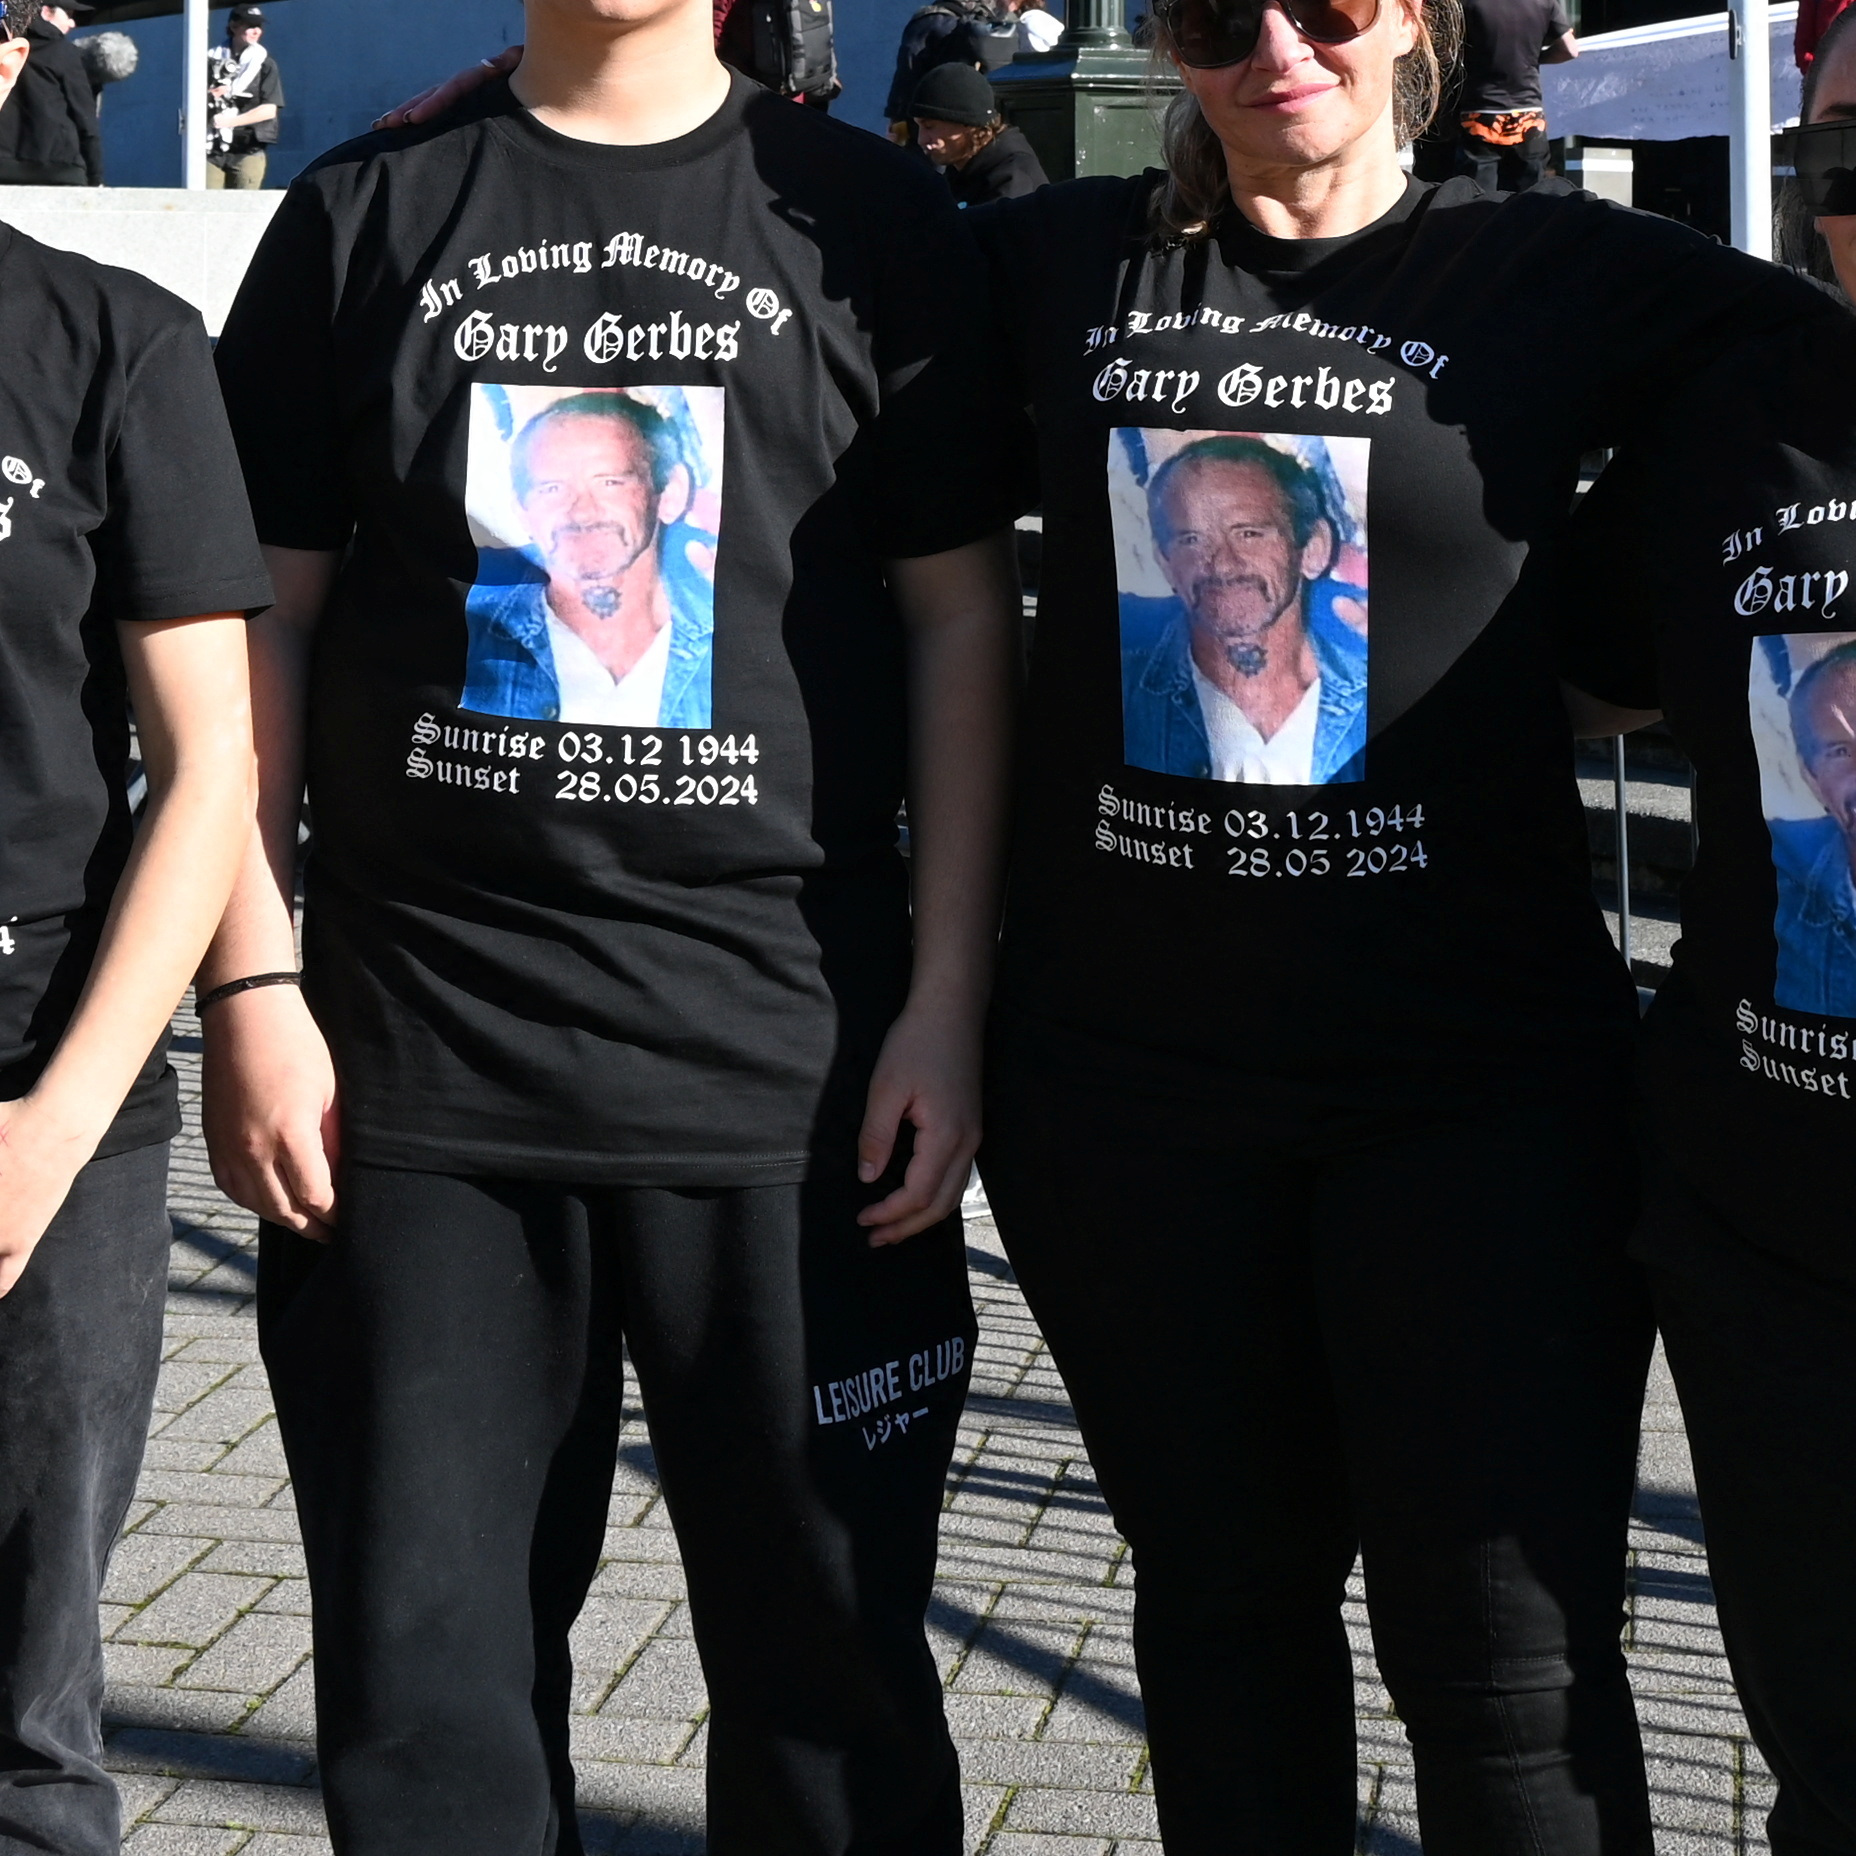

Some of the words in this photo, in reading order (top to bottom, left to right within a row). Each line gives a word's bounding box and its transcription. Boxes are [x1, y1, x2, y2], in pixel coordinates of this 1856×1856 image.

[419, 278, 464, 324] In
[468, 238, 593, 290] Loving
[601, 231, 740, 300] Memory
[745, 287, 793, 336] Of
[454, 309, 568, 373] Gary
[584, 310, 741, 364] Gerbes
[1083, 324, 1117, 356] In
[1126, 302, 1245, 339] Loving
[1249, 310, 1392, 355] Memory
[1400, 339, 1449, 380] Of
[1092, 357, 1201, 415] Gary
[1217, 362, 1396, 416] Gerbes
[1722, 525, 1763, 567] In
[1733, 566, 1849, 619] Gary
[411, 711, 546, 761] Sunrise
[406, 746, 520, 794] Sunset
[555, 770, 758, 806] 28.05.2024
[1097, 784, 1212, 834] Sunrise
[1224, 803, 1425, 841] 03.12.1944
[1094, 819, 1195, 869] Sunset
[1740, 1038, 1852, 1100] Sunset
[813, 1360, 903, 1426] LEISURE
[908, 1336, 965, 1392] CLUB
[861, 1406, 929, 1451] レジャー
